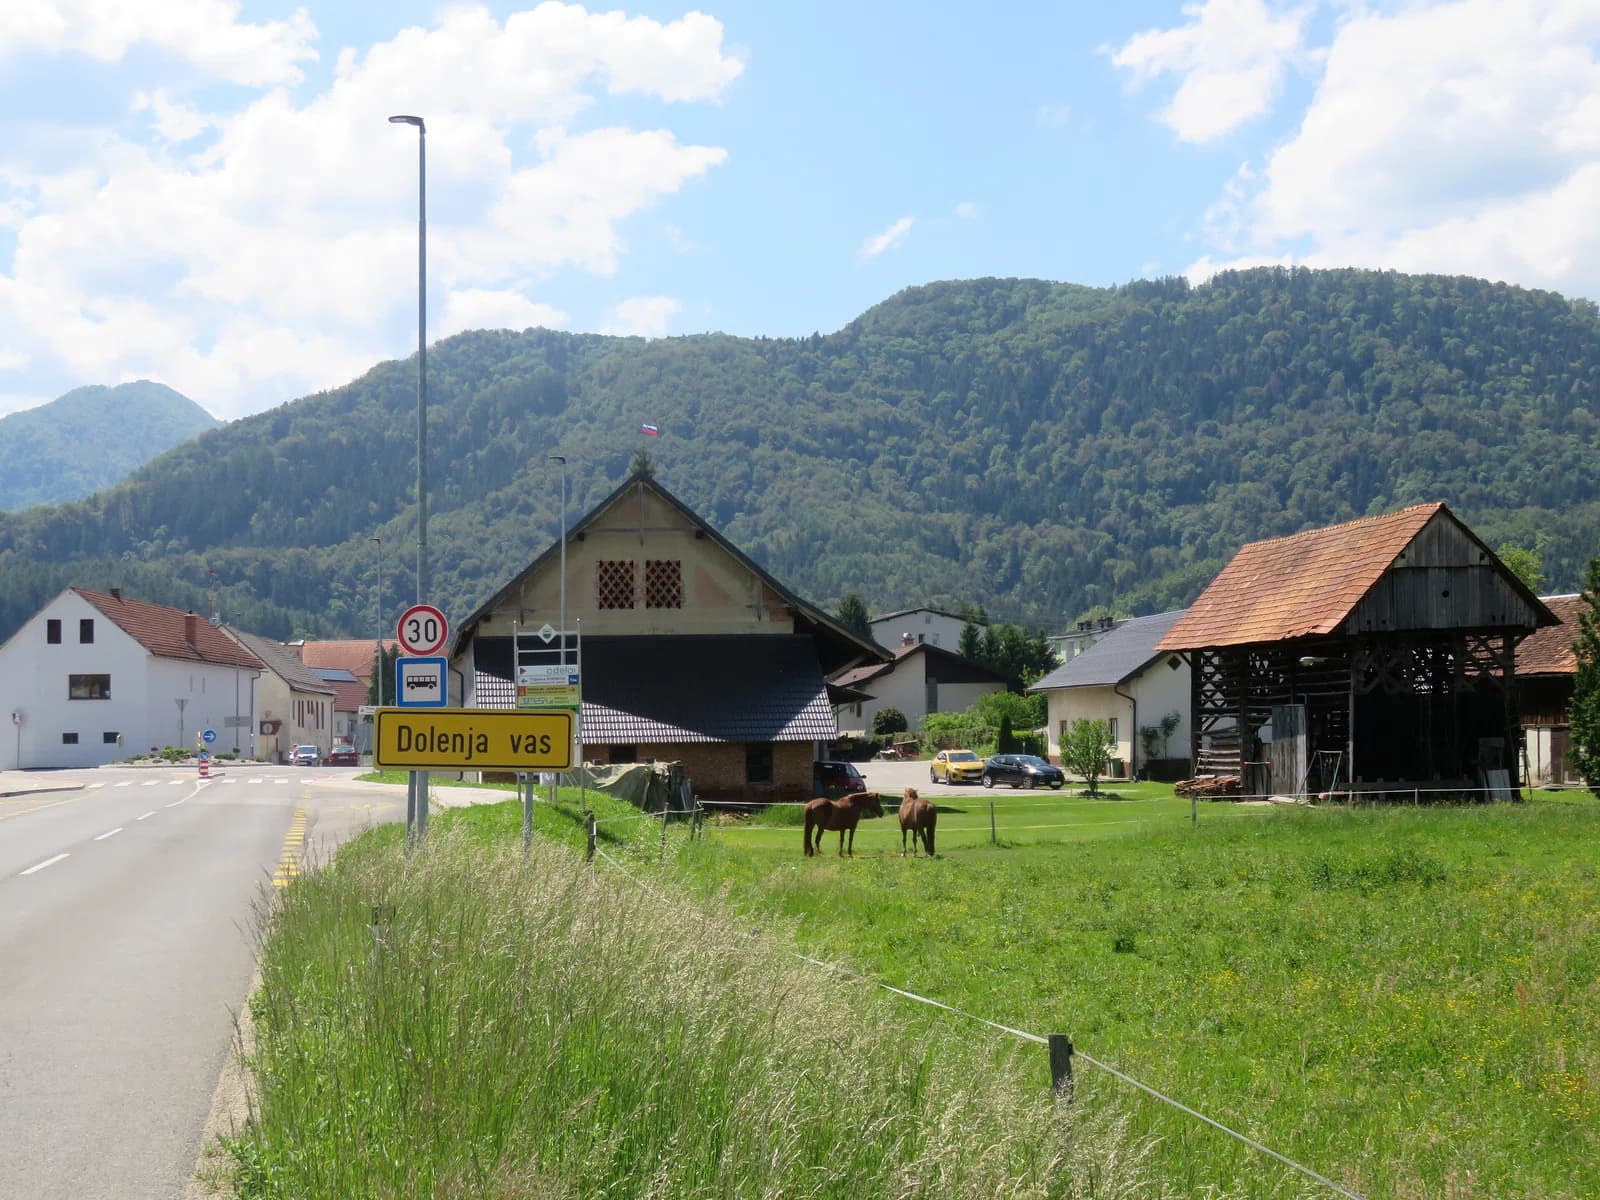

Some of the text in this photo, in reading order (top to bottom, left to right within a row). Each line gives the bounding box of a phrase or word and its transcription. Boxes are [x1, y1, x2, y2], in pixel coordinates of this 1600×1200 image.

[407, 618, 438, 644] 30
[397, 725, 552, 761] Dolenja vas
